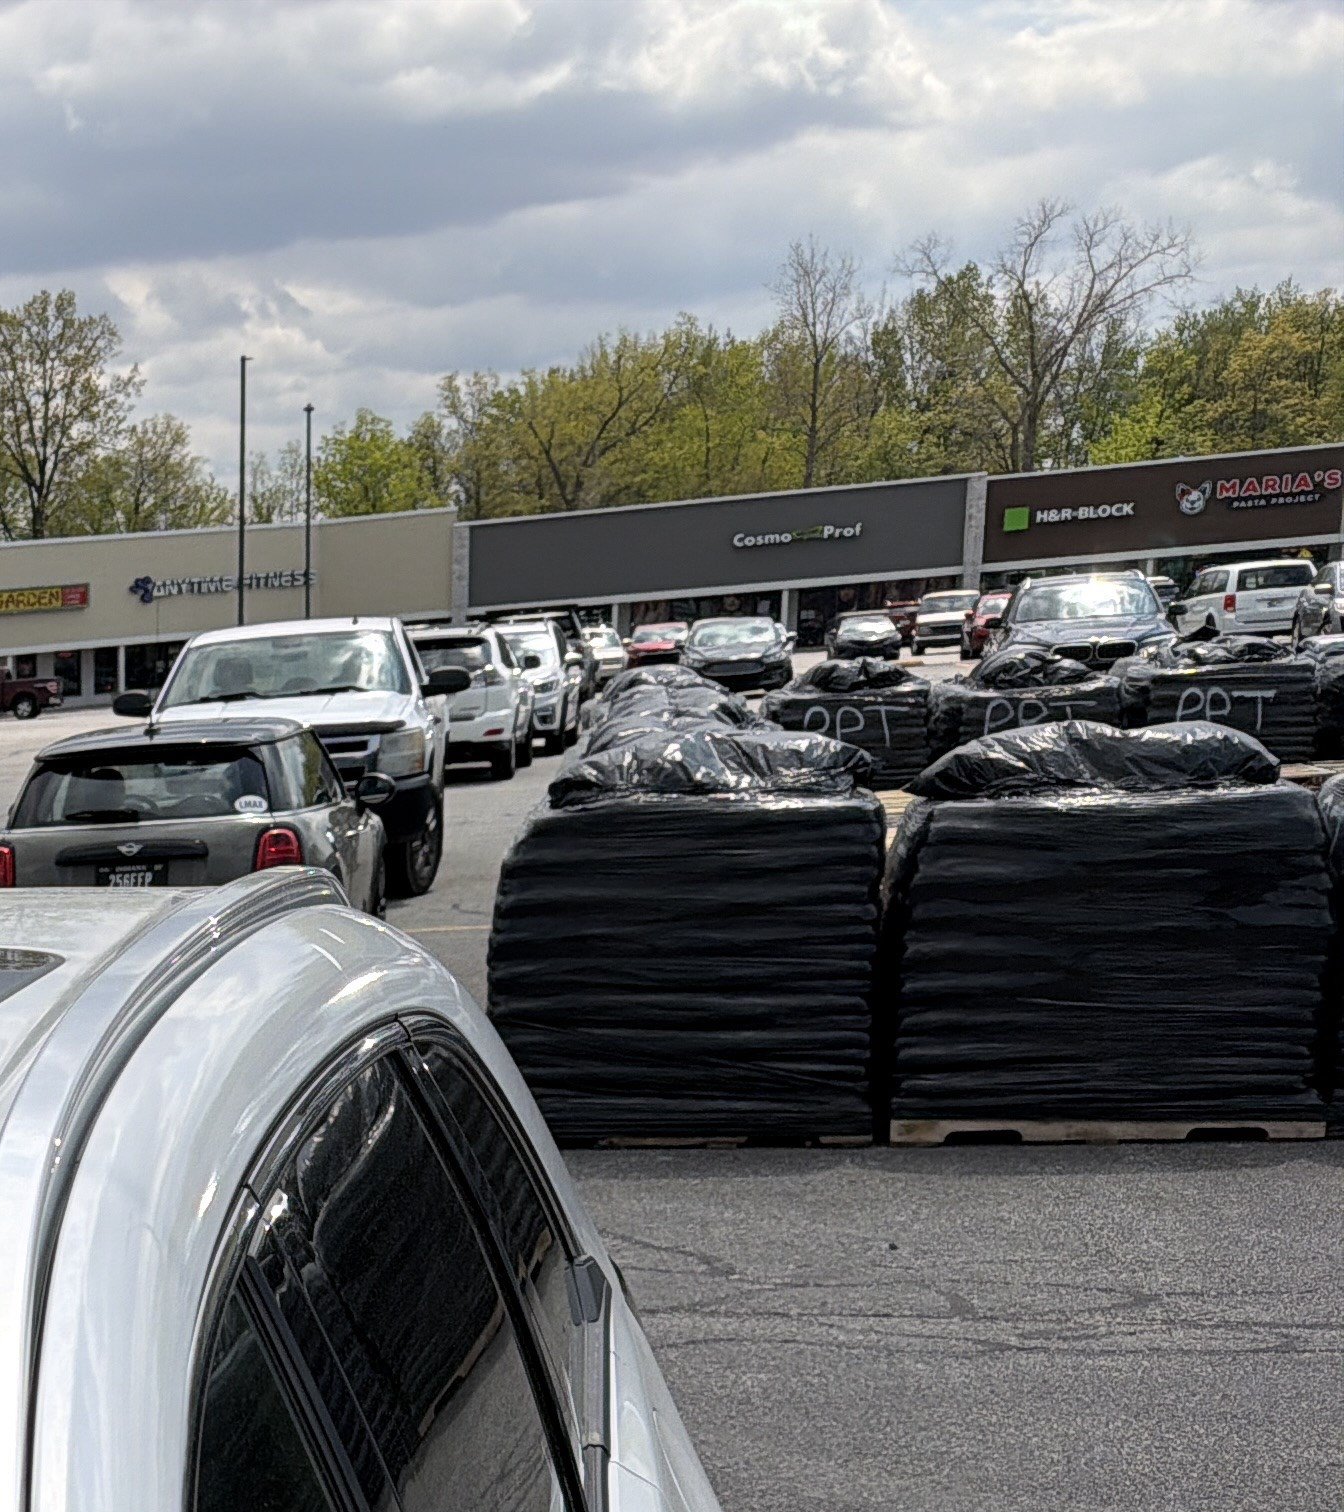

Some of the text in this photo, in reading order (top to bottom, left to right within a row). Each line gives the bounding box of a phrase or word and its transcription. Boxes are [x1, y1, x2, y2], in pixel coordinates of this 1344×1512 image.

[1216, 469, 1342, 499] MARIA'S
[1077, 502, 1135, 519] BLOCK
[1232, 493, 1321, 509] PASTA PROJECT
[733, 522, 863, 548] Cosmo Prof
[152, 569, 318, 597] ANYTIME FITNESS
